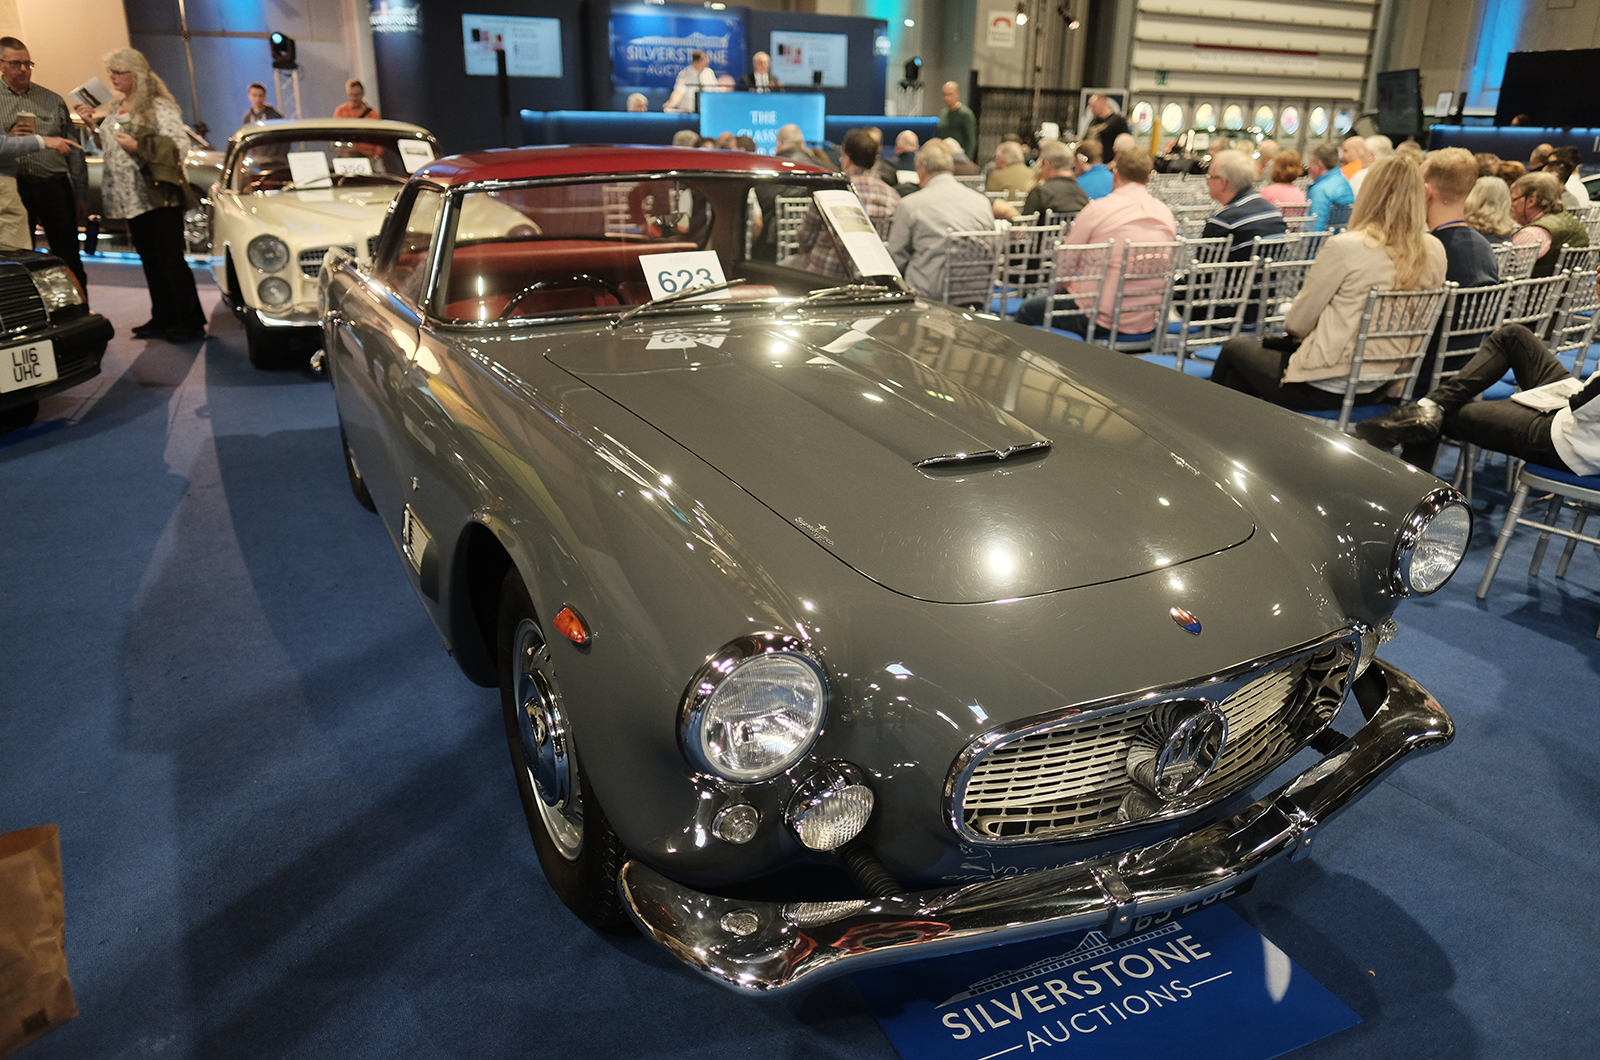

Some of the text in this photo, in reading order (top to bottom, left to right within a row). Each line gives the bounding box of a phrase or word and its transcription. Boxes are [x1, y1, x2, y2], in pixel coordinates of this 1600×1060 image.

[627, 45, 728, 65] SILVERSTNE
[750, 110, 777, 125] THE
[658, 268, 715, 293] 623
[12, 348, 38, 367] L116
[13, 363, 42, 382] UHC
[942, 935, 1211, 1040] SILVERSTONE
[1026, 979, 1192, 1052] AUCTIONS
